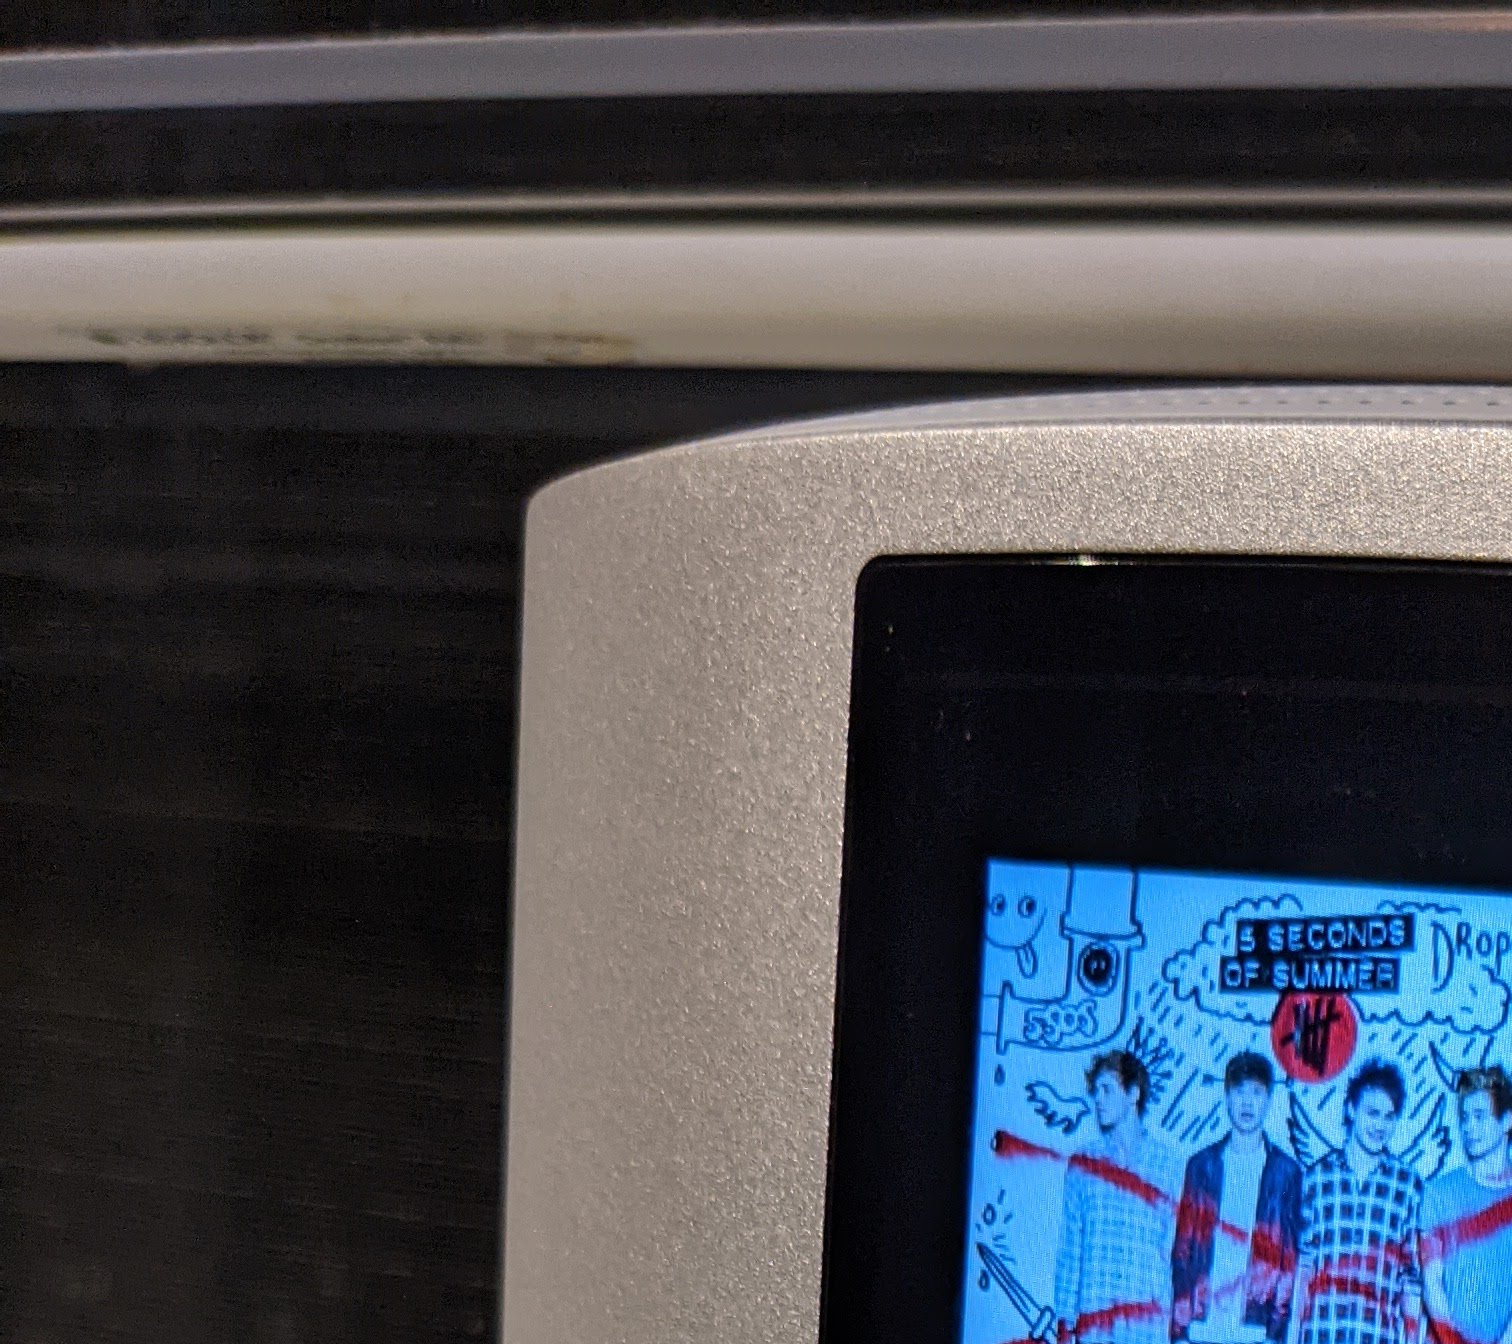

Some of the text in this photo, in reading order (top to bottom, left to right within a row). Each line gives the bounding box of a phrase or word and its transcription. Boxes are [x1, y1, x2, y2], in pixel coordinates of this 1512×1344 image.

[1238, 918, 1407, 952] 5 SECONDS
[1223, 960, 1396, 991] OF SUMMER
